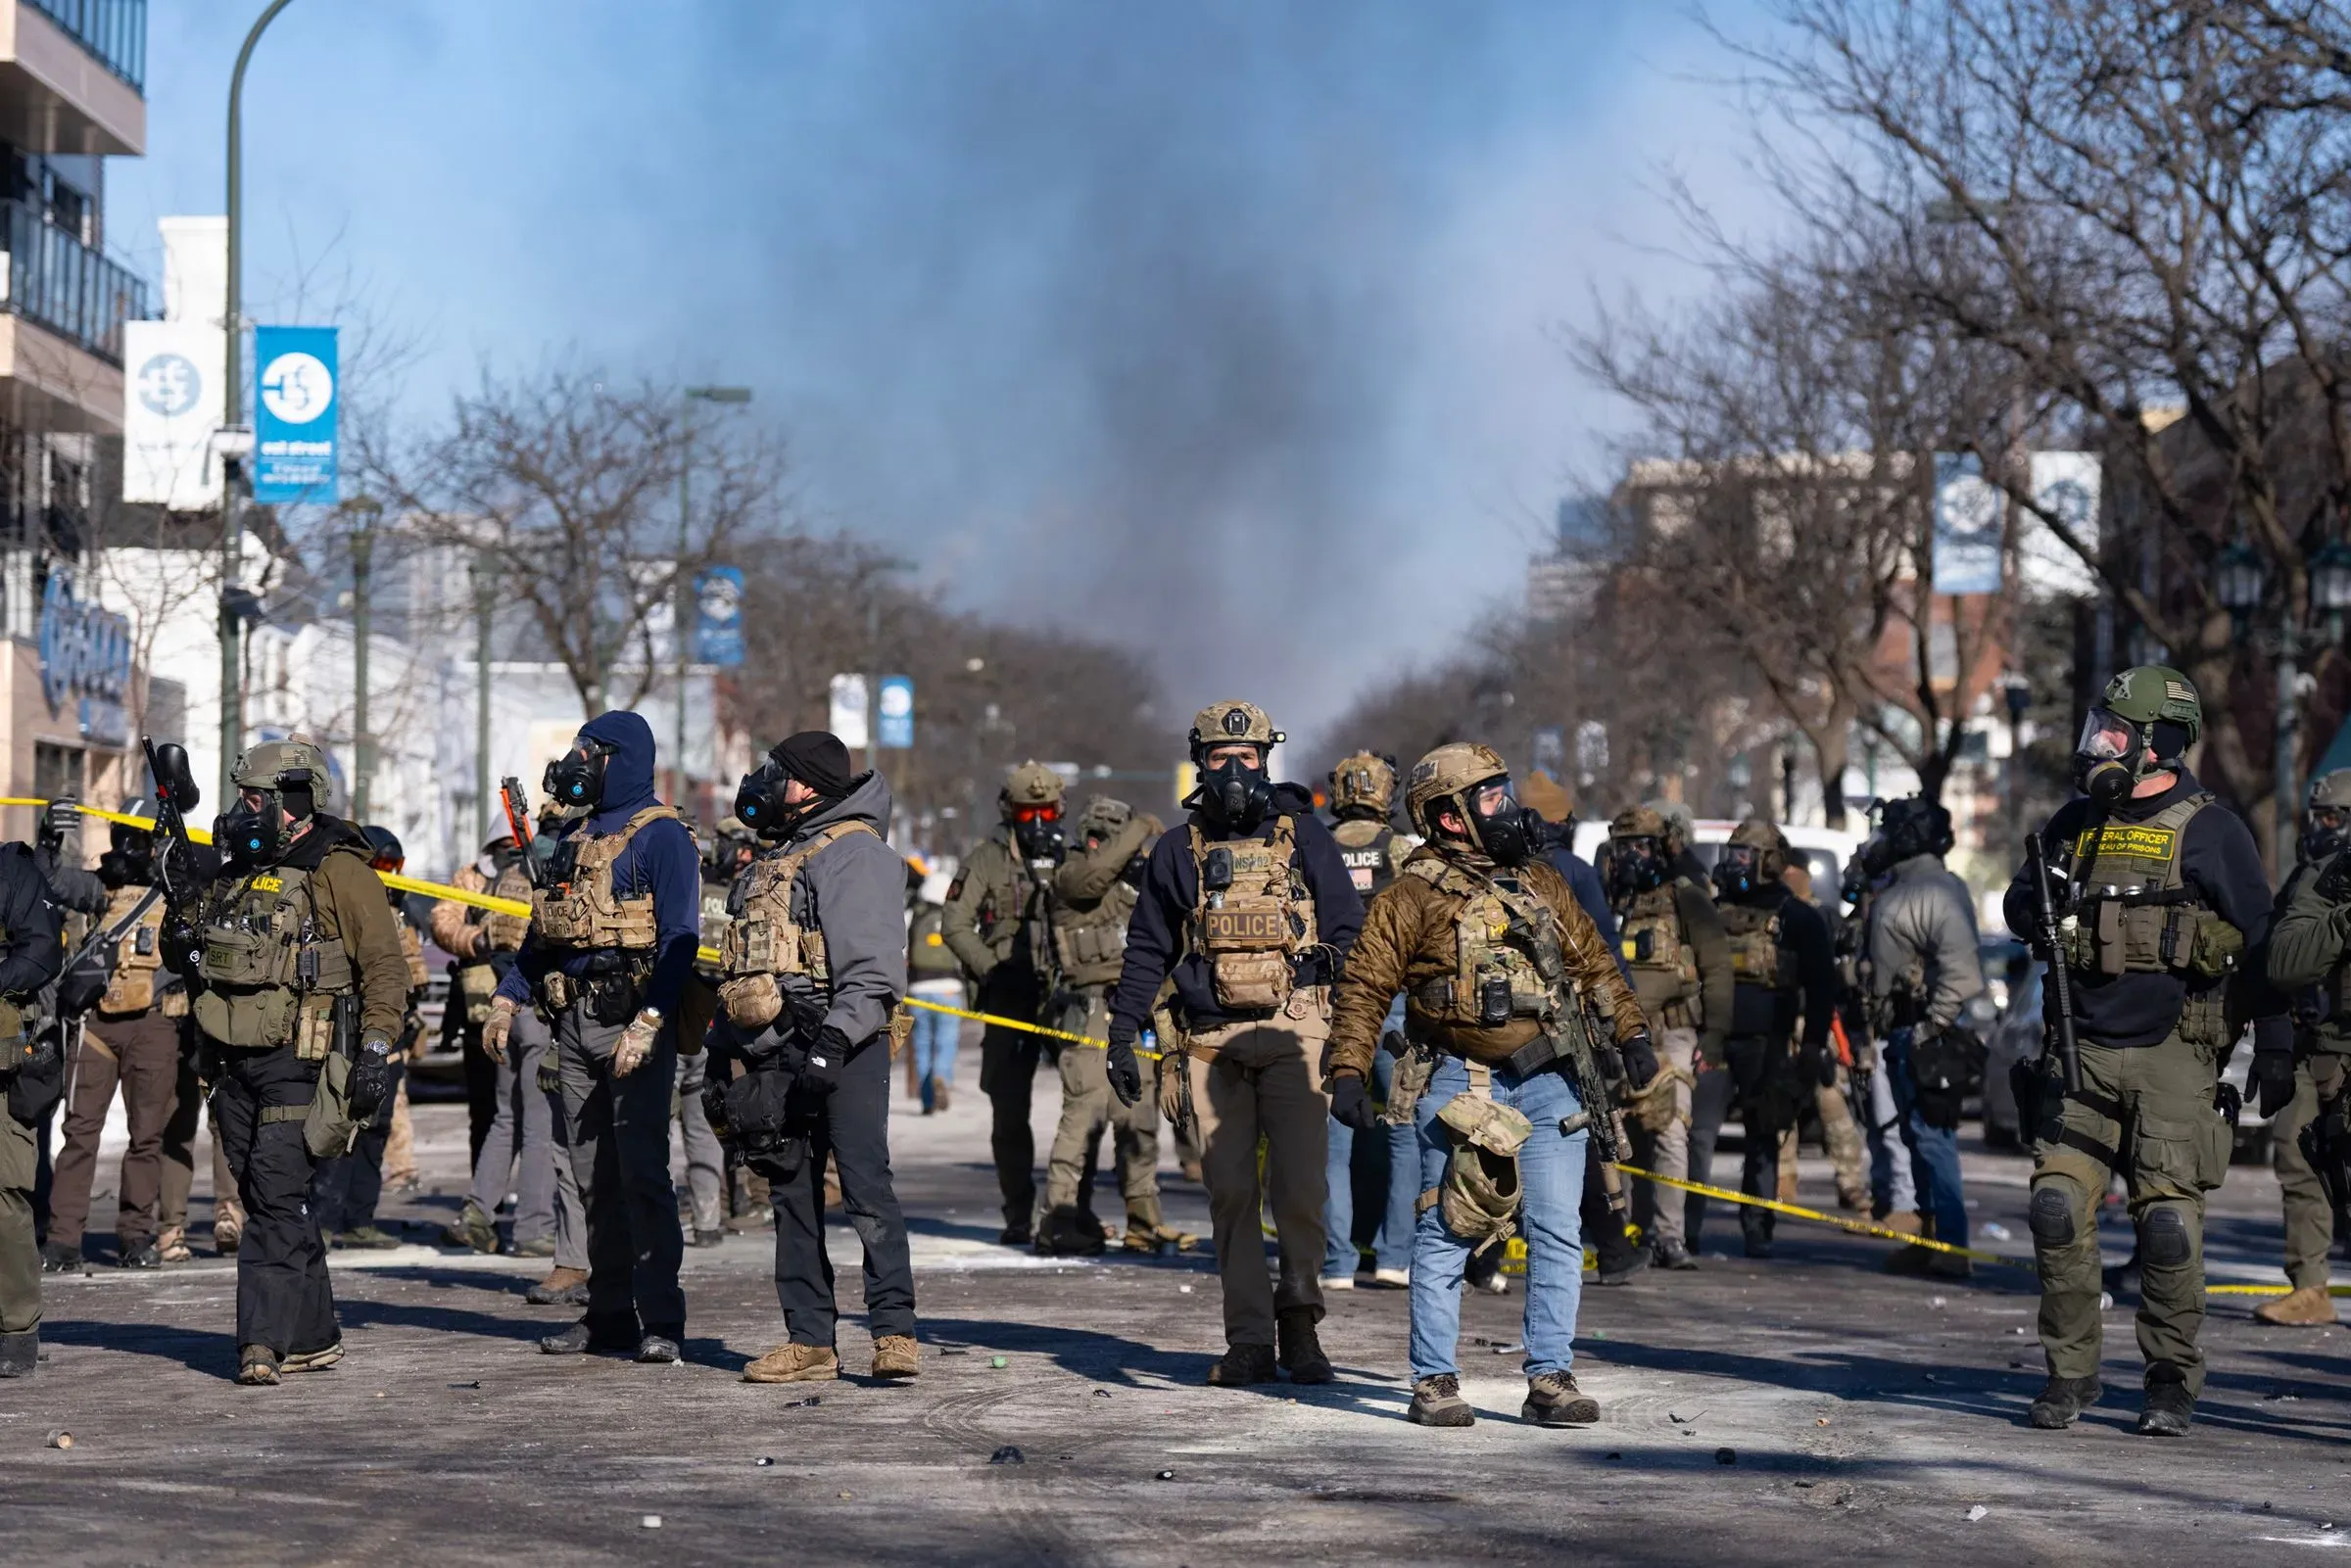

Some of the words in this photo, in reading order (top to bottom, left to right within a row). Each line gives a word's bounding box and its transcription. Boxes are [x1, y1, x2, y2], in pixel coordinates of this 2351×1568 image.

[2087, 832, 2125, 841] FERAL
[2127, 831, 2169, 844] OFFICER
[2127, 843, 2162, 855] PRISONS
[1342, 851, 1380, 868] OLICE
[240, 876, 283, 893] LICE
[1208, 915, 1277, 936] POLICE
[211, 950, 229, 963] SRT
